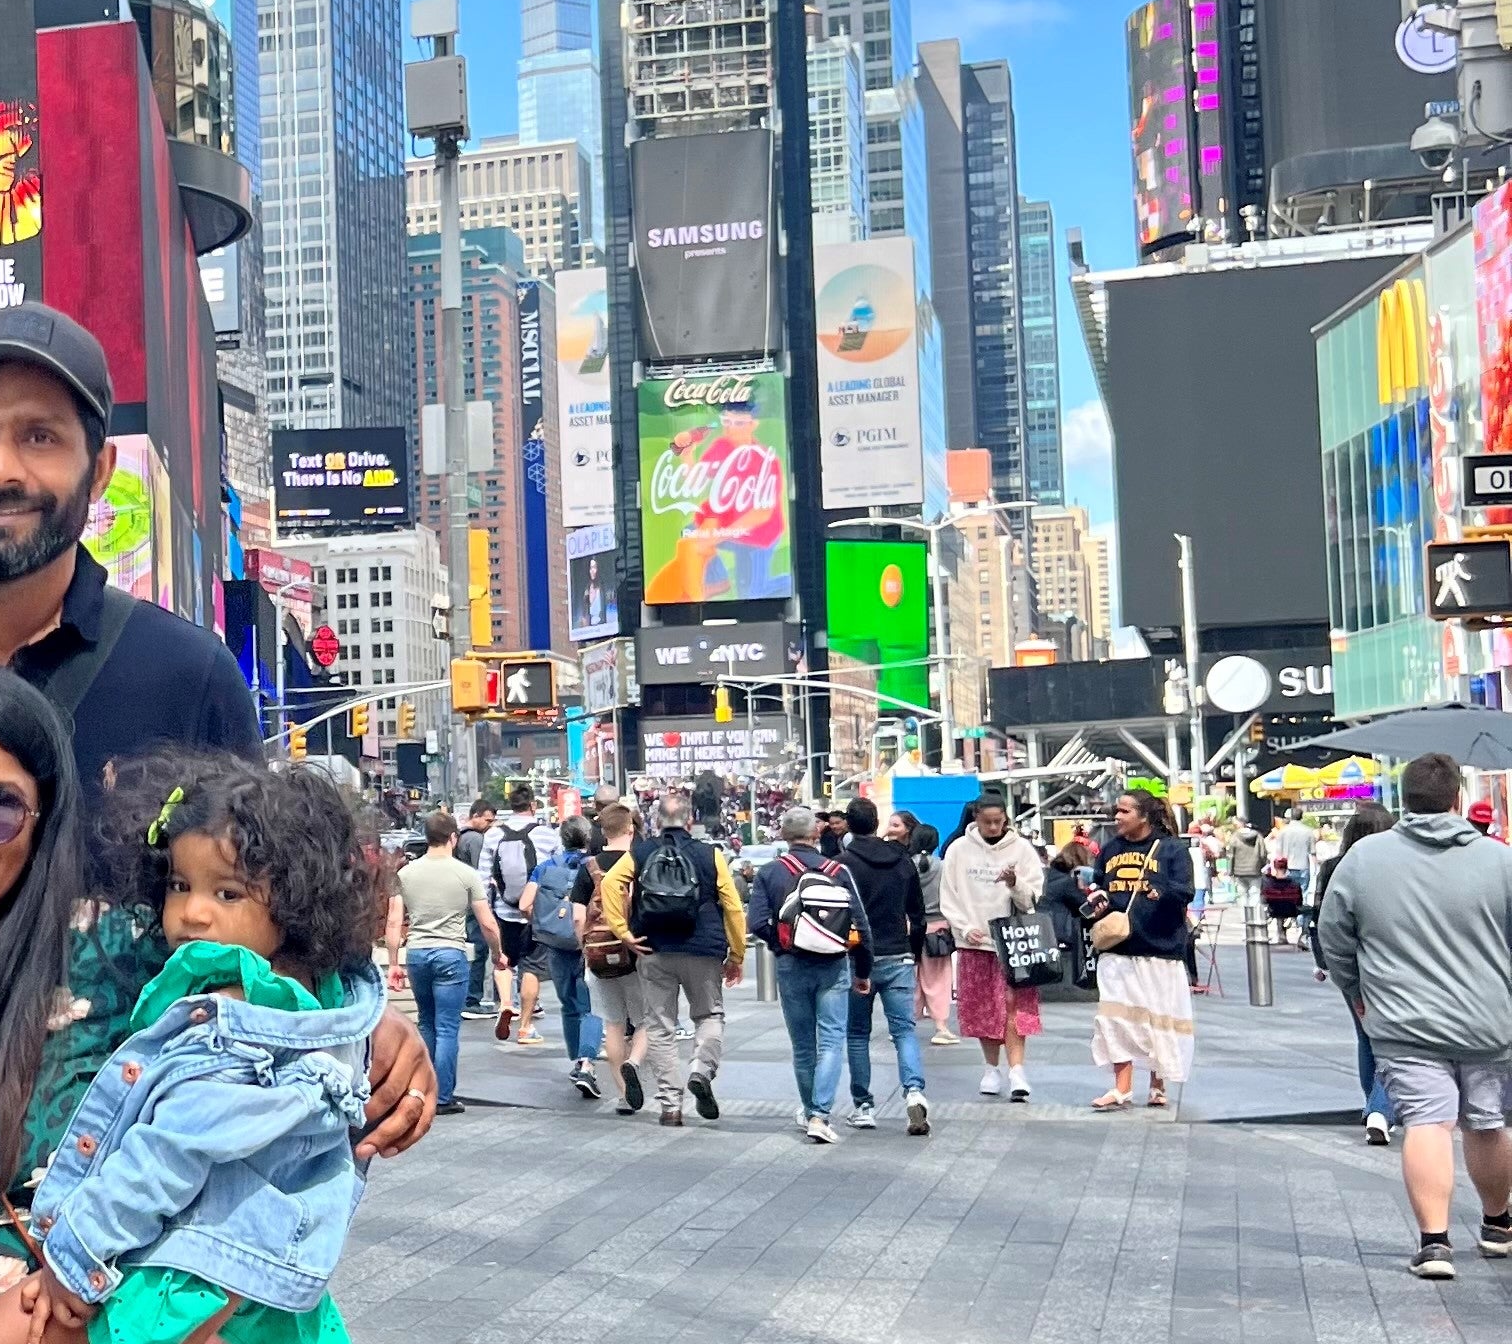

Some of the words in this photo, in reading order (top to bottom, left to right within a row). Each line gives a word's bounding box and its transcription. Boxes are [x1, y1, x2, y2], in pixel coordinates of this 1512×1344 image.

[648, 220, 763, 247] SAMSUNG
[835, 378, 872, 392] LEADING
[873, 375, 906, 388] GLOBAL
[828, 393, 855, 406] ASSET
[857, 390, 899, 404] MANAGER
[569, 415, 594, 427] ASSET
[857, 427, 897, 443] PGIM
[289, 453, 323, 469] Text
[325, 453, 346, 470] OR
[348, 451, 391, 468] Drive.
[282, 471, 325, 487] There
[341, 470, 362, 486] No
[651, 443, 777, 516] Coca-Cola
[654, 646, 692, 665] WE
[644, 733, 663, 746] WE
[680, 731, 710, 745] THAT
[712, 730, 725, 744] IF
[645, 748, 677, 761] MAKE
[680, 747, 692, 760] IT
[694, 745, 725, 760] HERE
[1001, 924, 1040, 940] How
[1005, 937, 1039, 955] you
